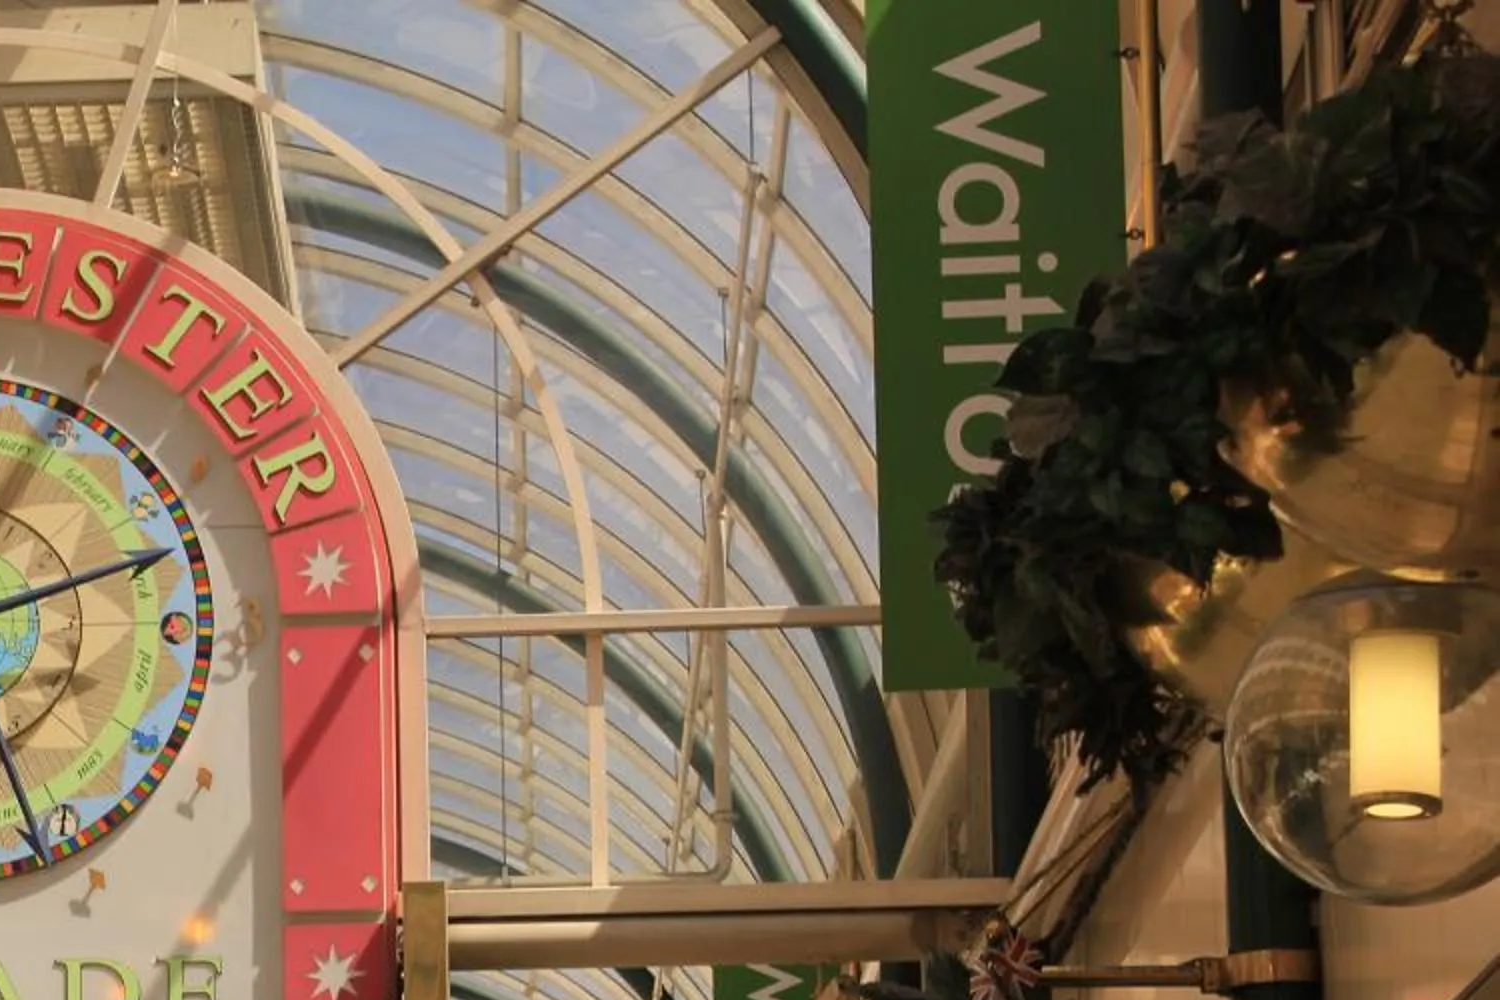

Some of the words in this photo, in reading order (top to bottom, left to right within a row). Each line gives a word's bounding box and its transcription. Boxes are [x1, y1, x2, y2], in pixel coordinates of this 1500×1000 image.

[931, 20, 1066, 612] Waitro
[136, 649, 153, 694] april
[77, 749, 104, 780] may
